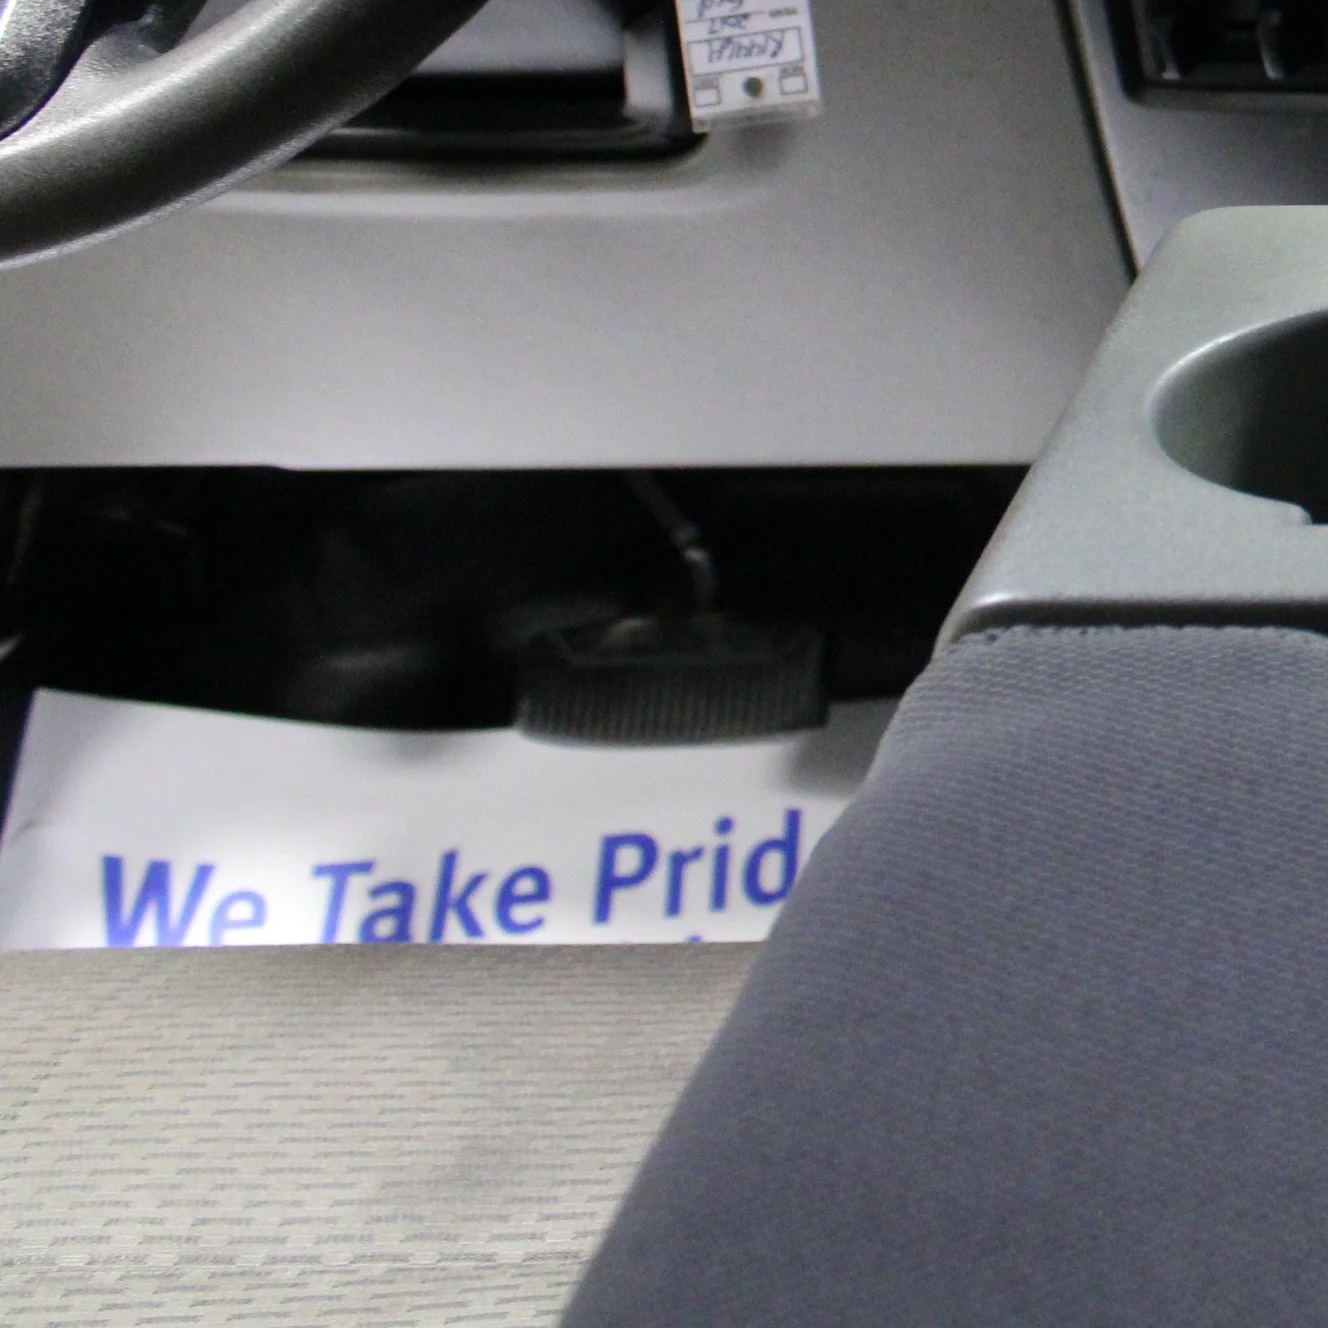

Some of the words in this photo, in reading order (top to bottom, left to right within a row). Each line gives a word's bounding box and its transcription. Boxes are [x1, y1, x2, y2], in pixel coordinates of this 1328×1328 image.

[100, 854, 268, 947] We
[310, 849, 553, 944] Take
[591, 808, 803, 926] Prid
